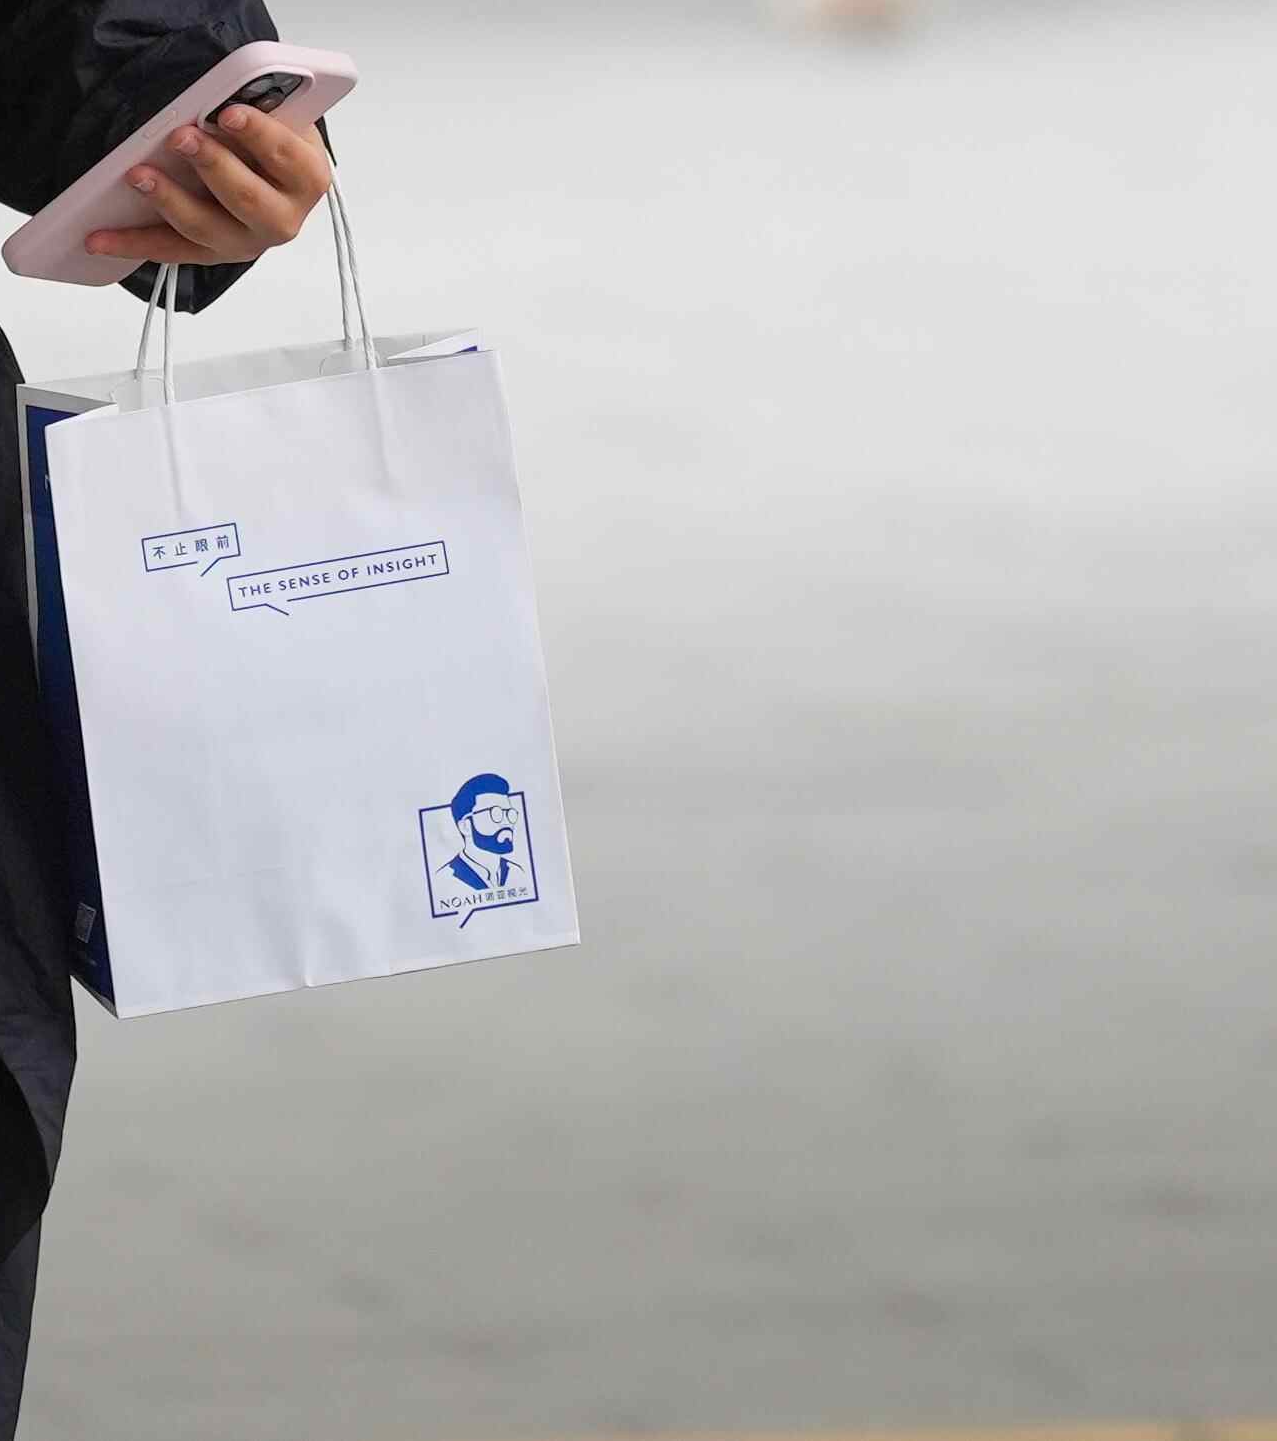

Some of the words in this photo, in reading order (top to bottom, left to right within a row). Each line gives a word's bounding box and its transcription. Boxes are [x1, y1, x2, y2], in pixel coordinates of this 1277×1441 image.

[153, 534, 230, 559] 不止眼前
[238, 582, 272, 598] THE
[278, 571, 332, 592] SENSE
[338, 566, 360, 581] OF
[366, 553, 438, 576] INSIGHT
[439, 894, 483, 909] NOAH
